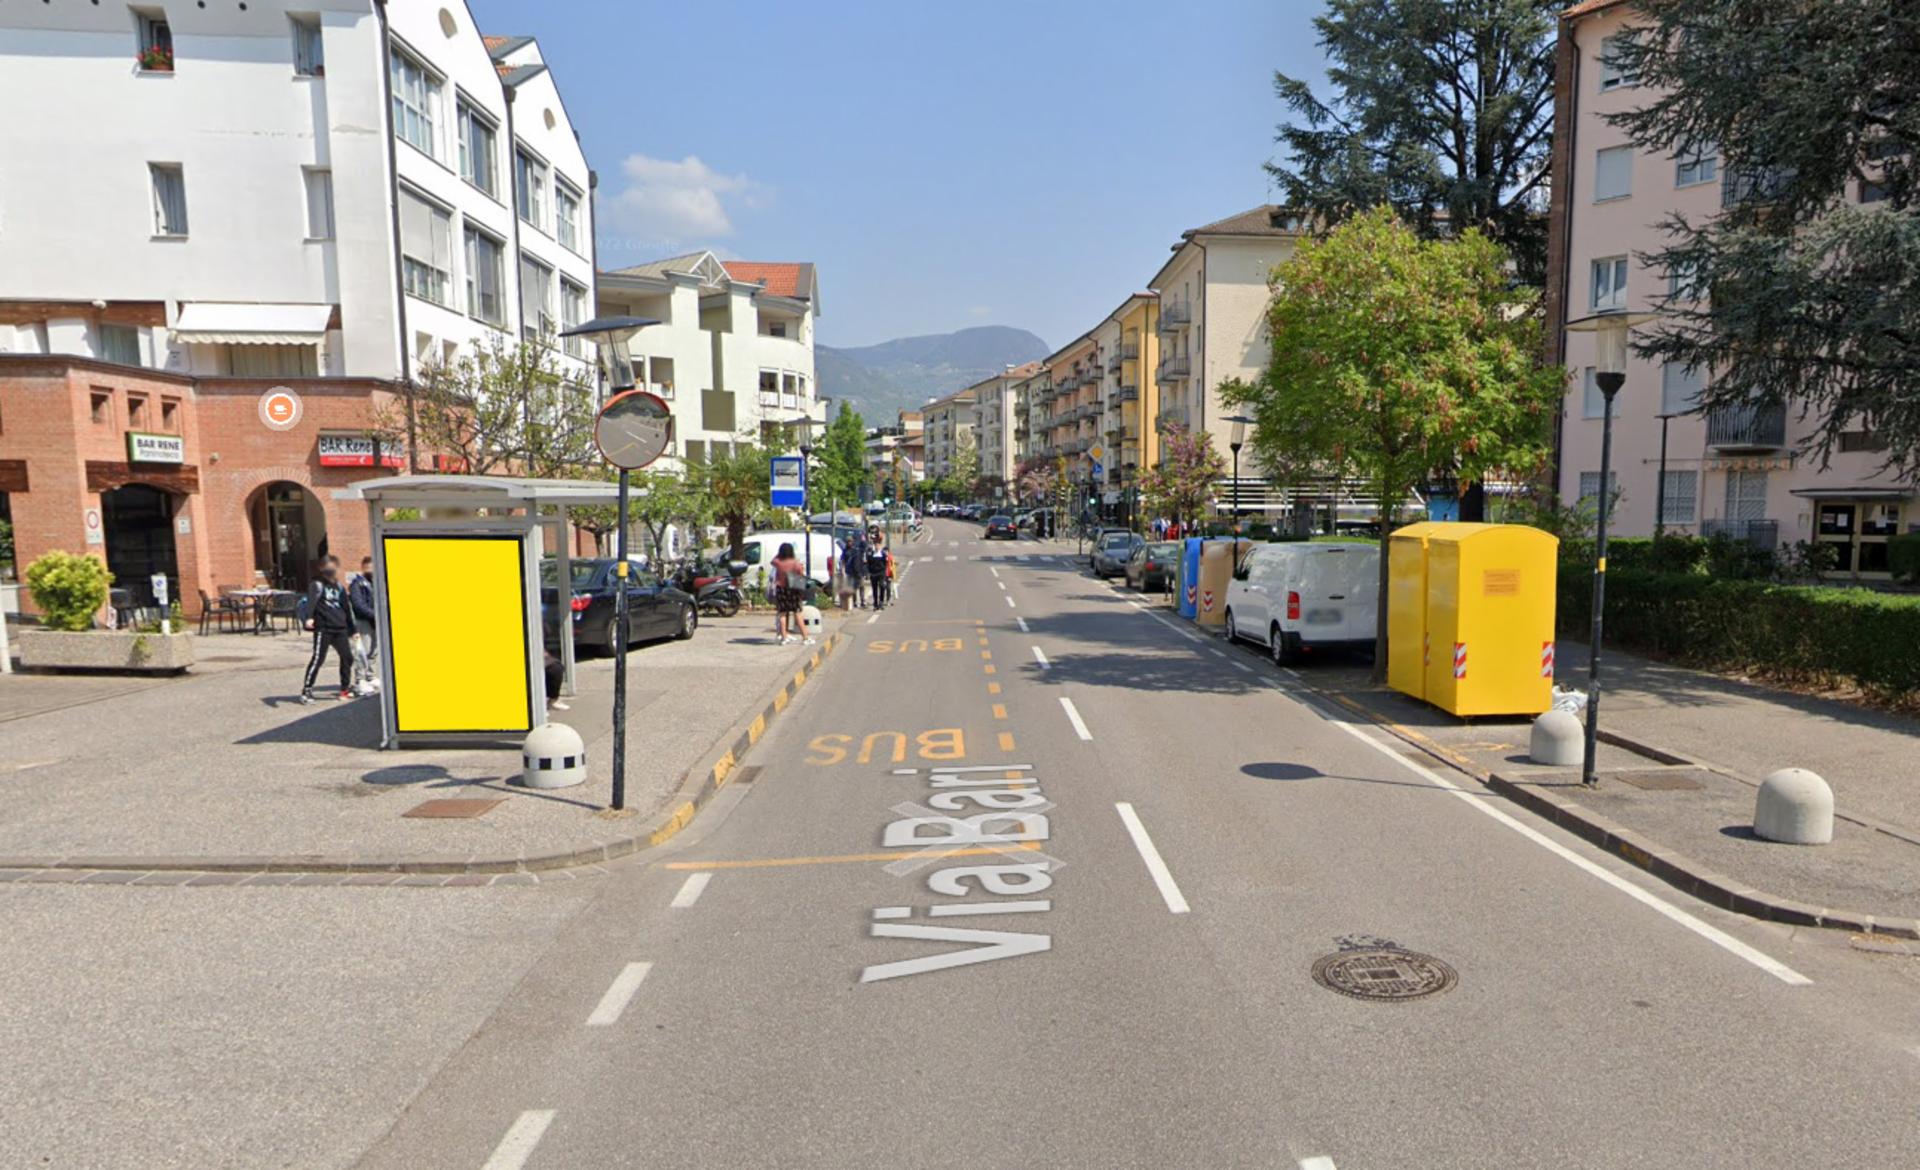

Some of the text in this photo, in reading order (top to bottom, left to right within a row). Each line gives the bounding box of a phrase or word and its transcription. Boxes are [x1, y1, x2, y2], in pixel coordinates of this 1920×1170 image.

[137, 438, 180, 451] BAR RENE
[320, 438, 344, 453] BAR
[866, 638, 964, 654] BUS
[804, 728, 965, 766] BUS
